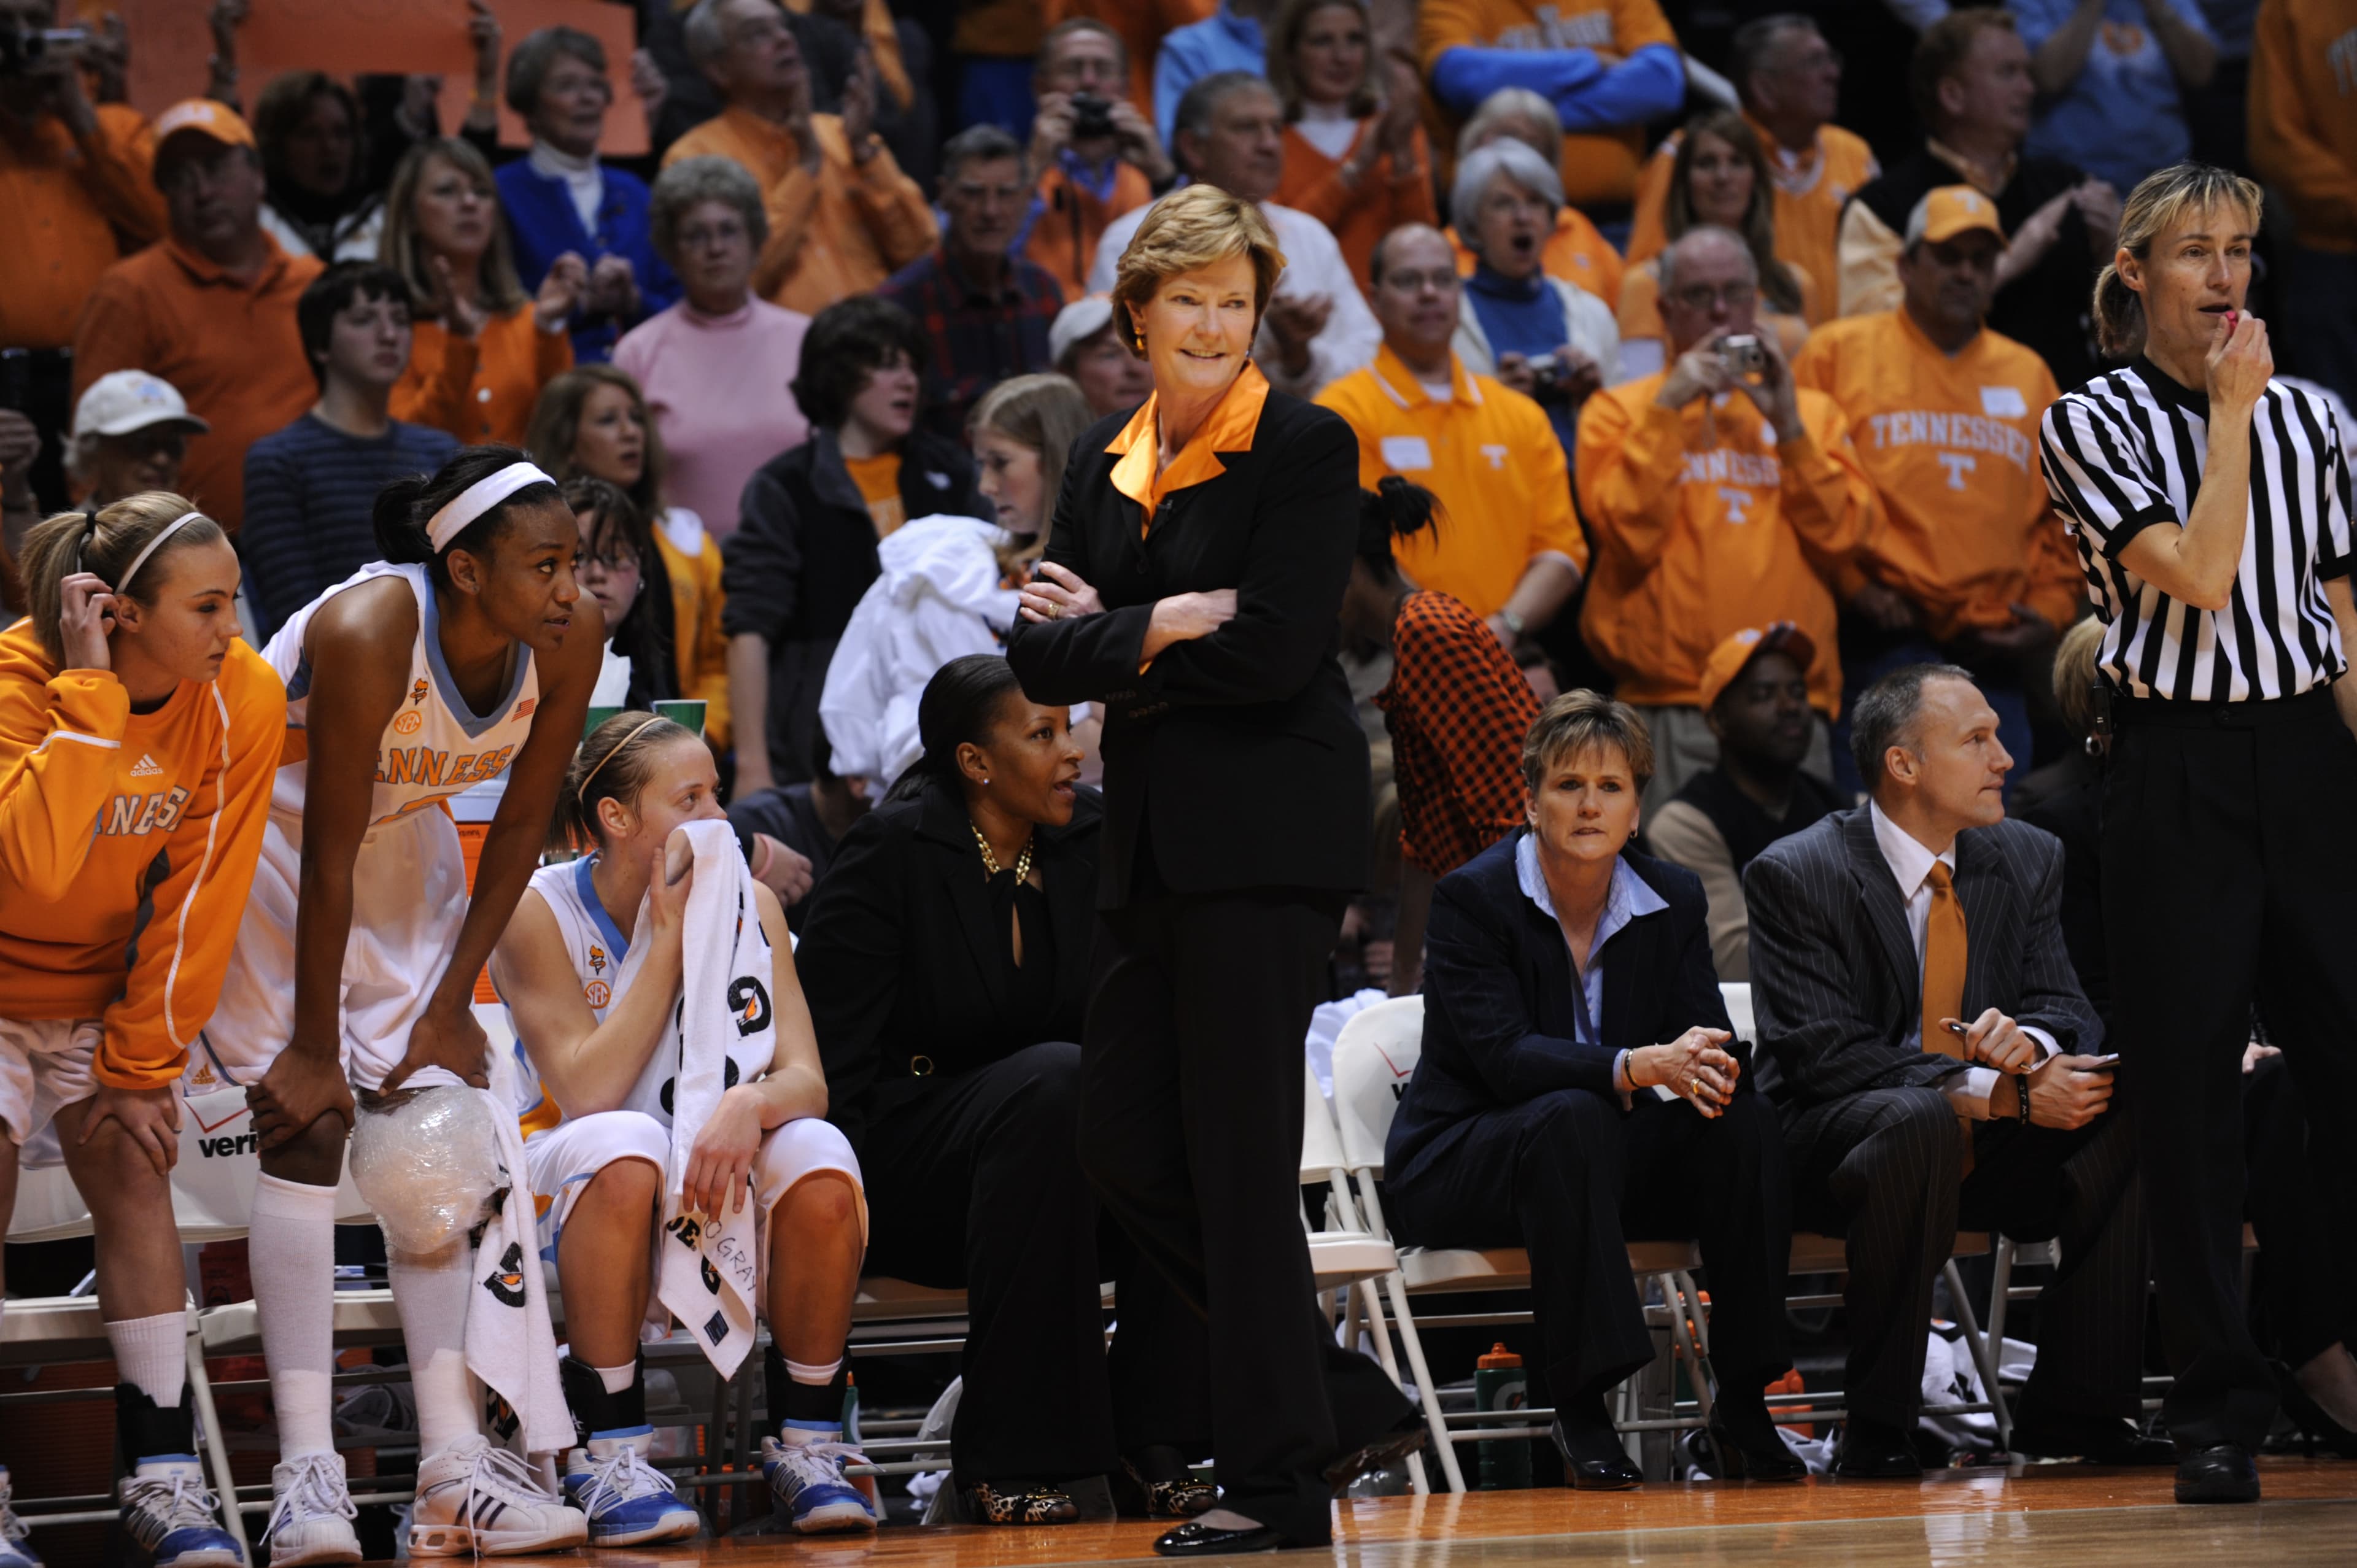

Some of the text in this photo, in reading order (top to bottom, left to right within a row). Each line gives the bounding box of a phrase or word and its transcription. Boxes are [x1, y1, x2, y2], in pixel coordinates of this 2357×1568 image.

[1938, 452, 1976, 490] T
[1718, 487, 1753, 523] T
[395, 711, 422, 734] SEC
[130, 767, 163, 776] adidas
[586, 983, 609, 1007] SEC
[192, 1076, 216, 1085] adidas
